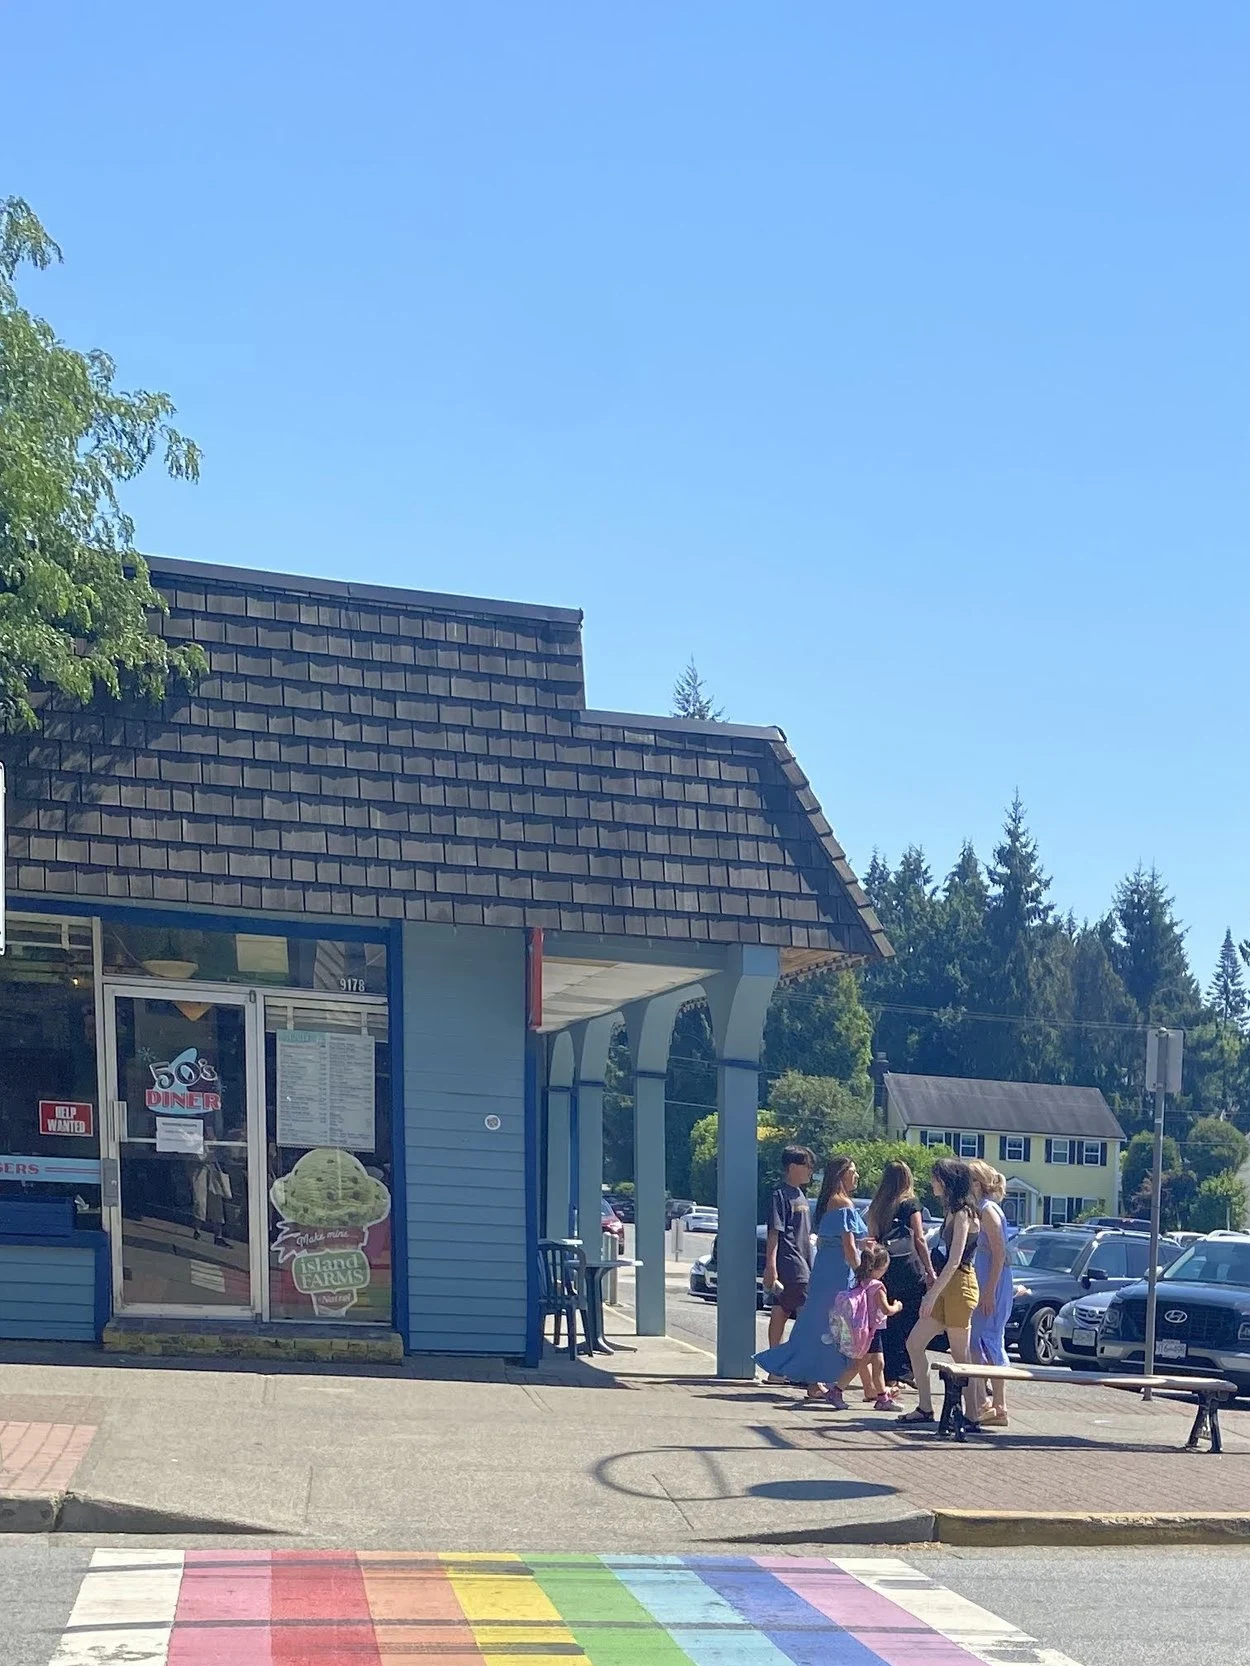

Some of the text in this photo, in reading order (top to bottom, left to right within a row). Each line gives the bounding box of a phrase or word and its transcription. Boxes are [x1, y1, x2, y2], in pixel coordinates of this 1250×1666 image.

[340, 978, 365, 992] 9178
[149, 1058, 218, 1090] 50's
[146, 1088, 221, 1111] DINER
[55, 1105, 76, 1120] HELP
[47, 1118, 86, 1133] WANTED
[296, 1229, 349, 1247] Make mine
[300, 1253, 359, 1274] island
[301, 1269, 364, 1289] FARMS
